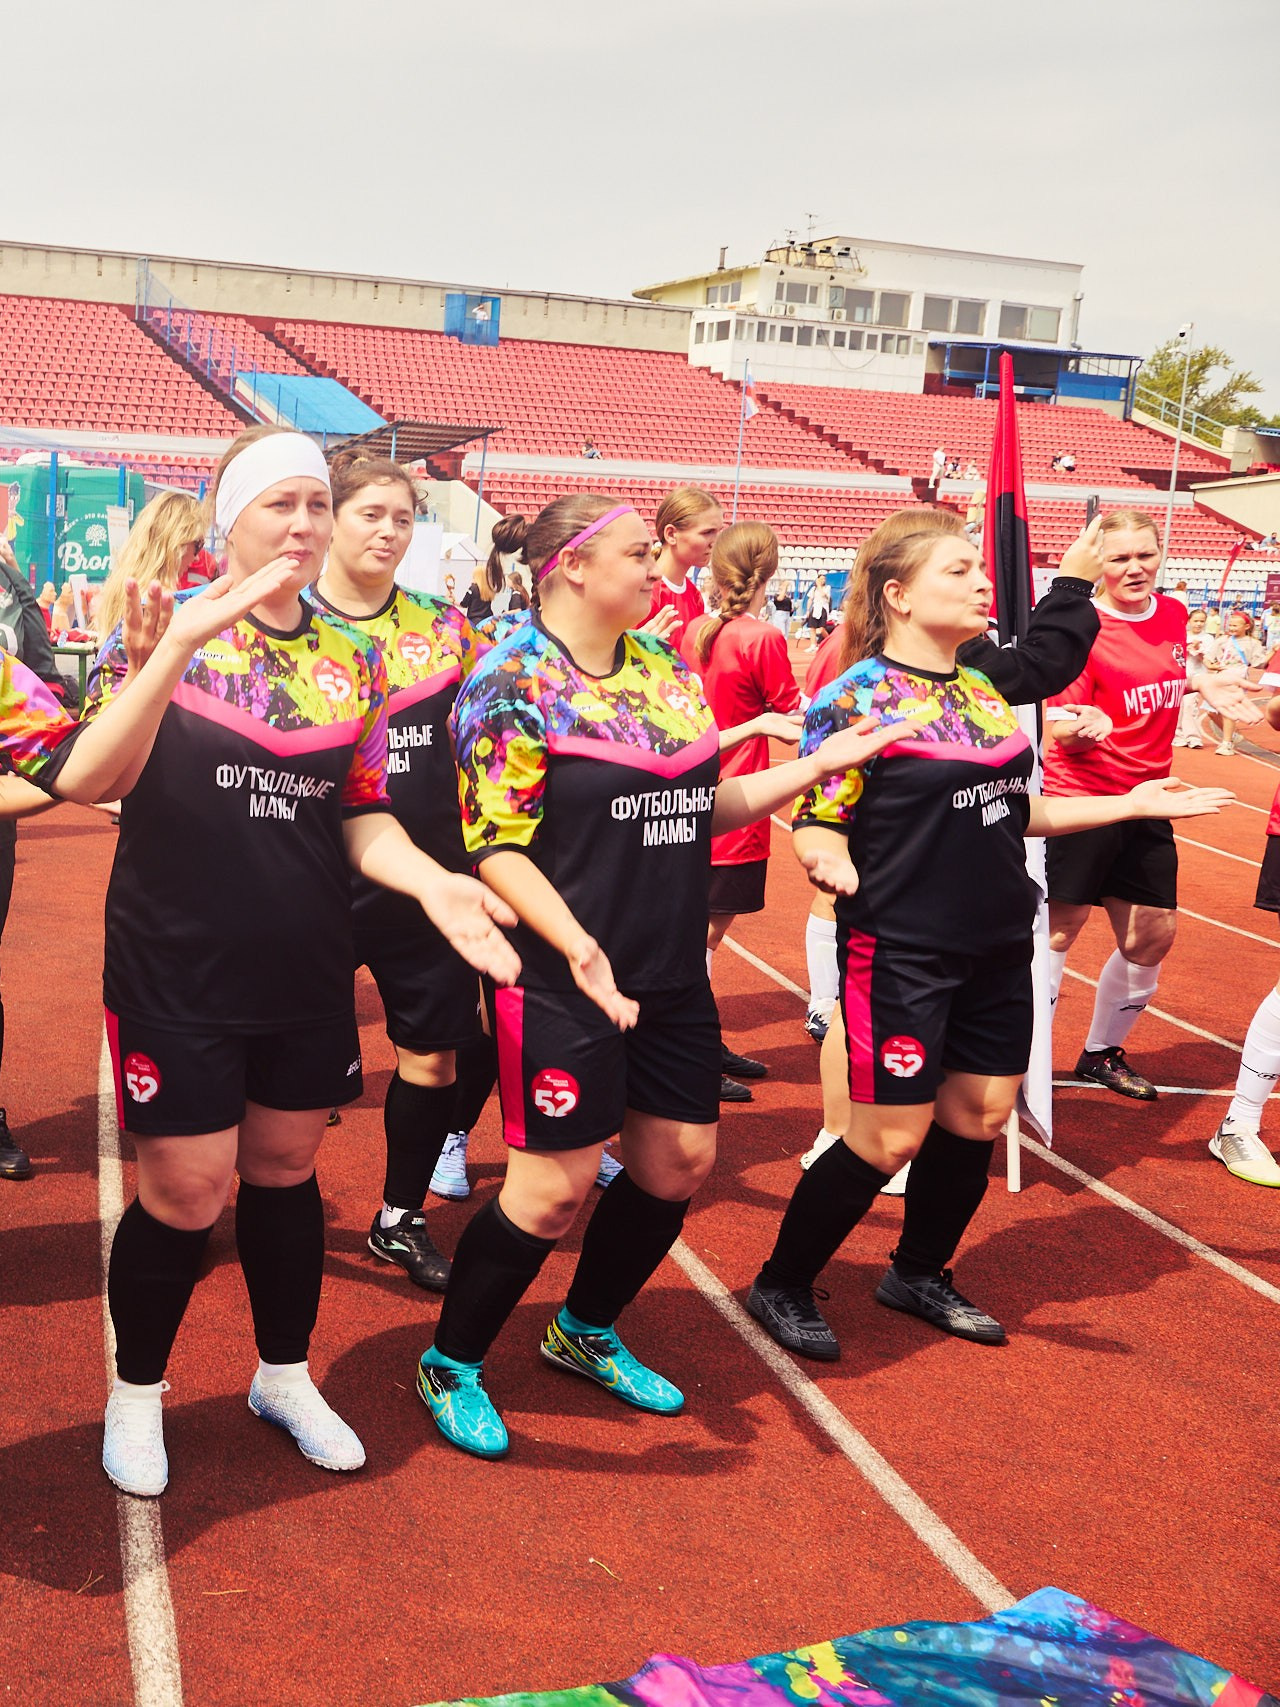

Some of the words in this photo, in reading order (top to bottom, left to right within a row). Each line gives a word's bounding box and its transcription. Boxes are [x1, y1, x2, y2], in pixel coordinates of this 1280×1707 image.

[400, 644, 431, 665] 52
[316, 673, 351, 702] 52
[215, 764, 336, 800] ФУТБОЛЬНЫЕ
[952, 776, 1030, 810] ФУТБОЛЬНЫ
[642, 816, 697, 847] МАМЫ
[884, 1053, 923, 1078] 52
[126, 1072, 158, 1103] 52
[535, 1089, 577, 1118] 52
